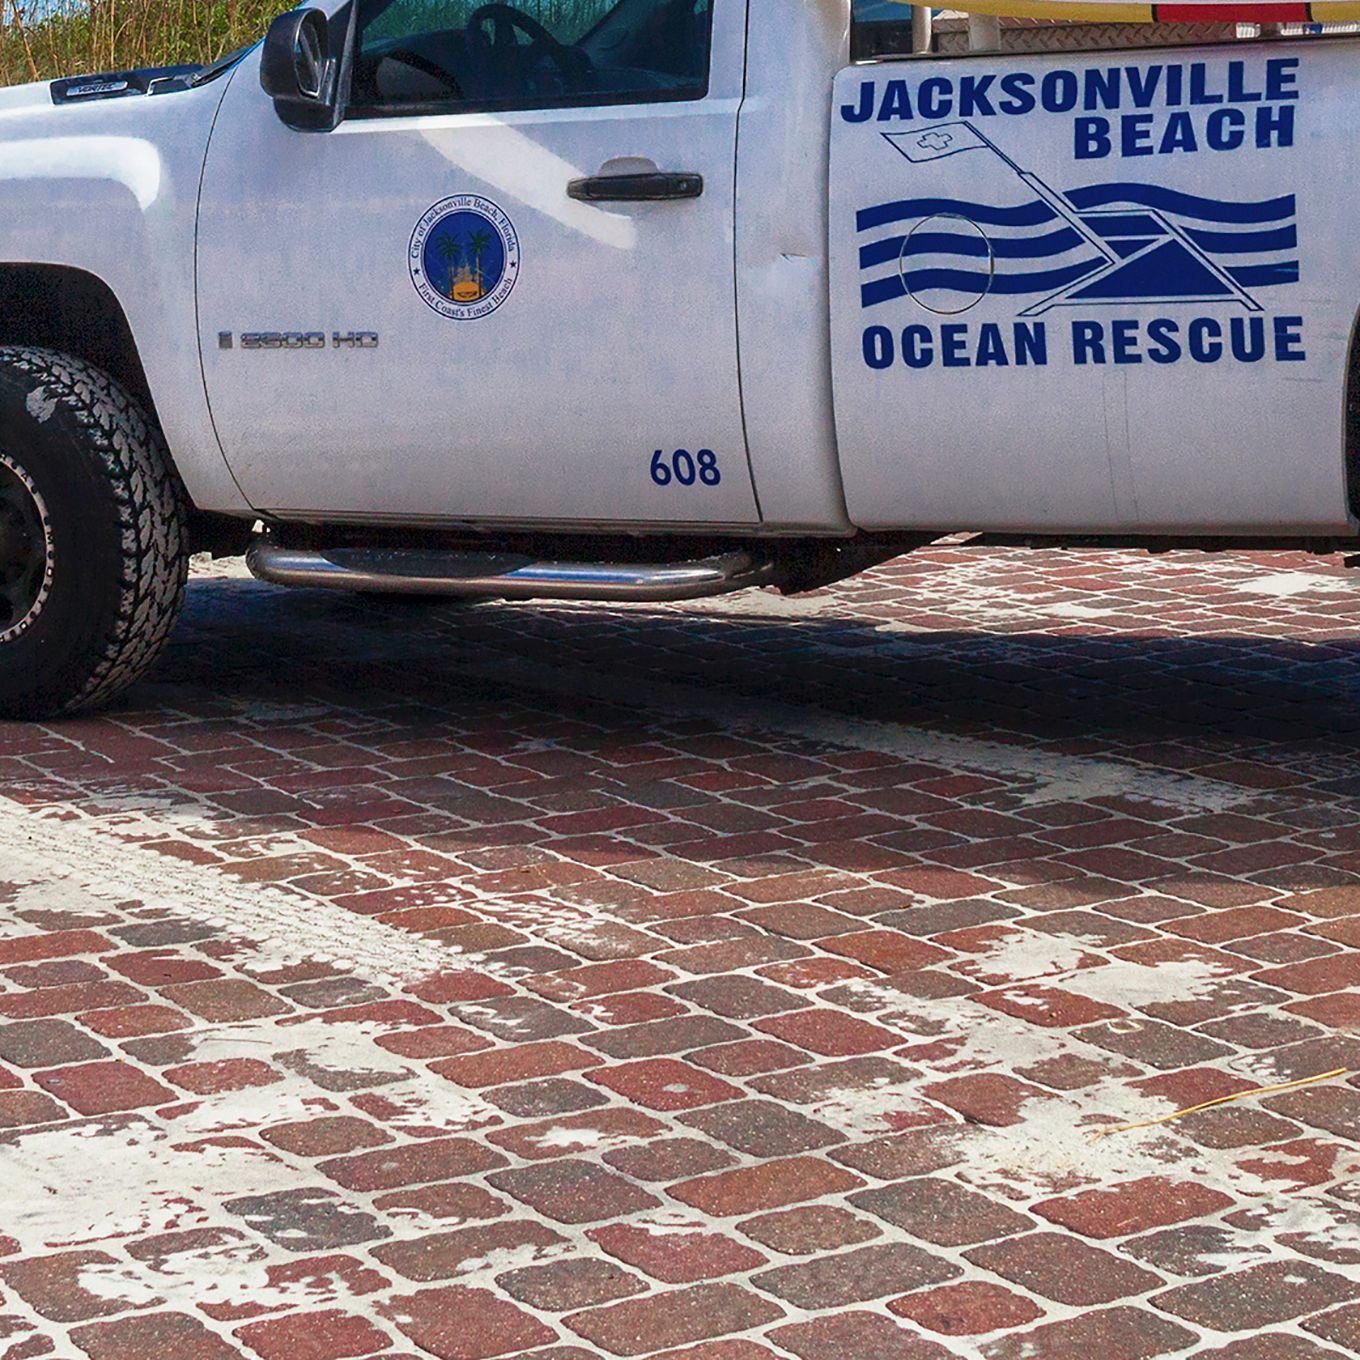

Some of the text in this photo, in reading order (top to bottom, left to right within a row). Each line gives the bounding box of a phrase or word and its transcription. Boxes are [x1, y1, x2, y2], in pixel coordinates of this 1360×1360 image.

[840, 57, 1300, 124] JACKSONVILLE
[1074, 105, 1295, 160] BEACH
[412, 237, 424, 258] City
[422, 197, 472, 228] Jacksonville
[500, 218, 515, 252] Florida
[419, 277, 513, 317] First Coast's Finest Beach
[331, 331, 379, 349] HD
[862, 315, 1307, 369] OCEAN RESCUE
[650, 448, 721, 486] 608
